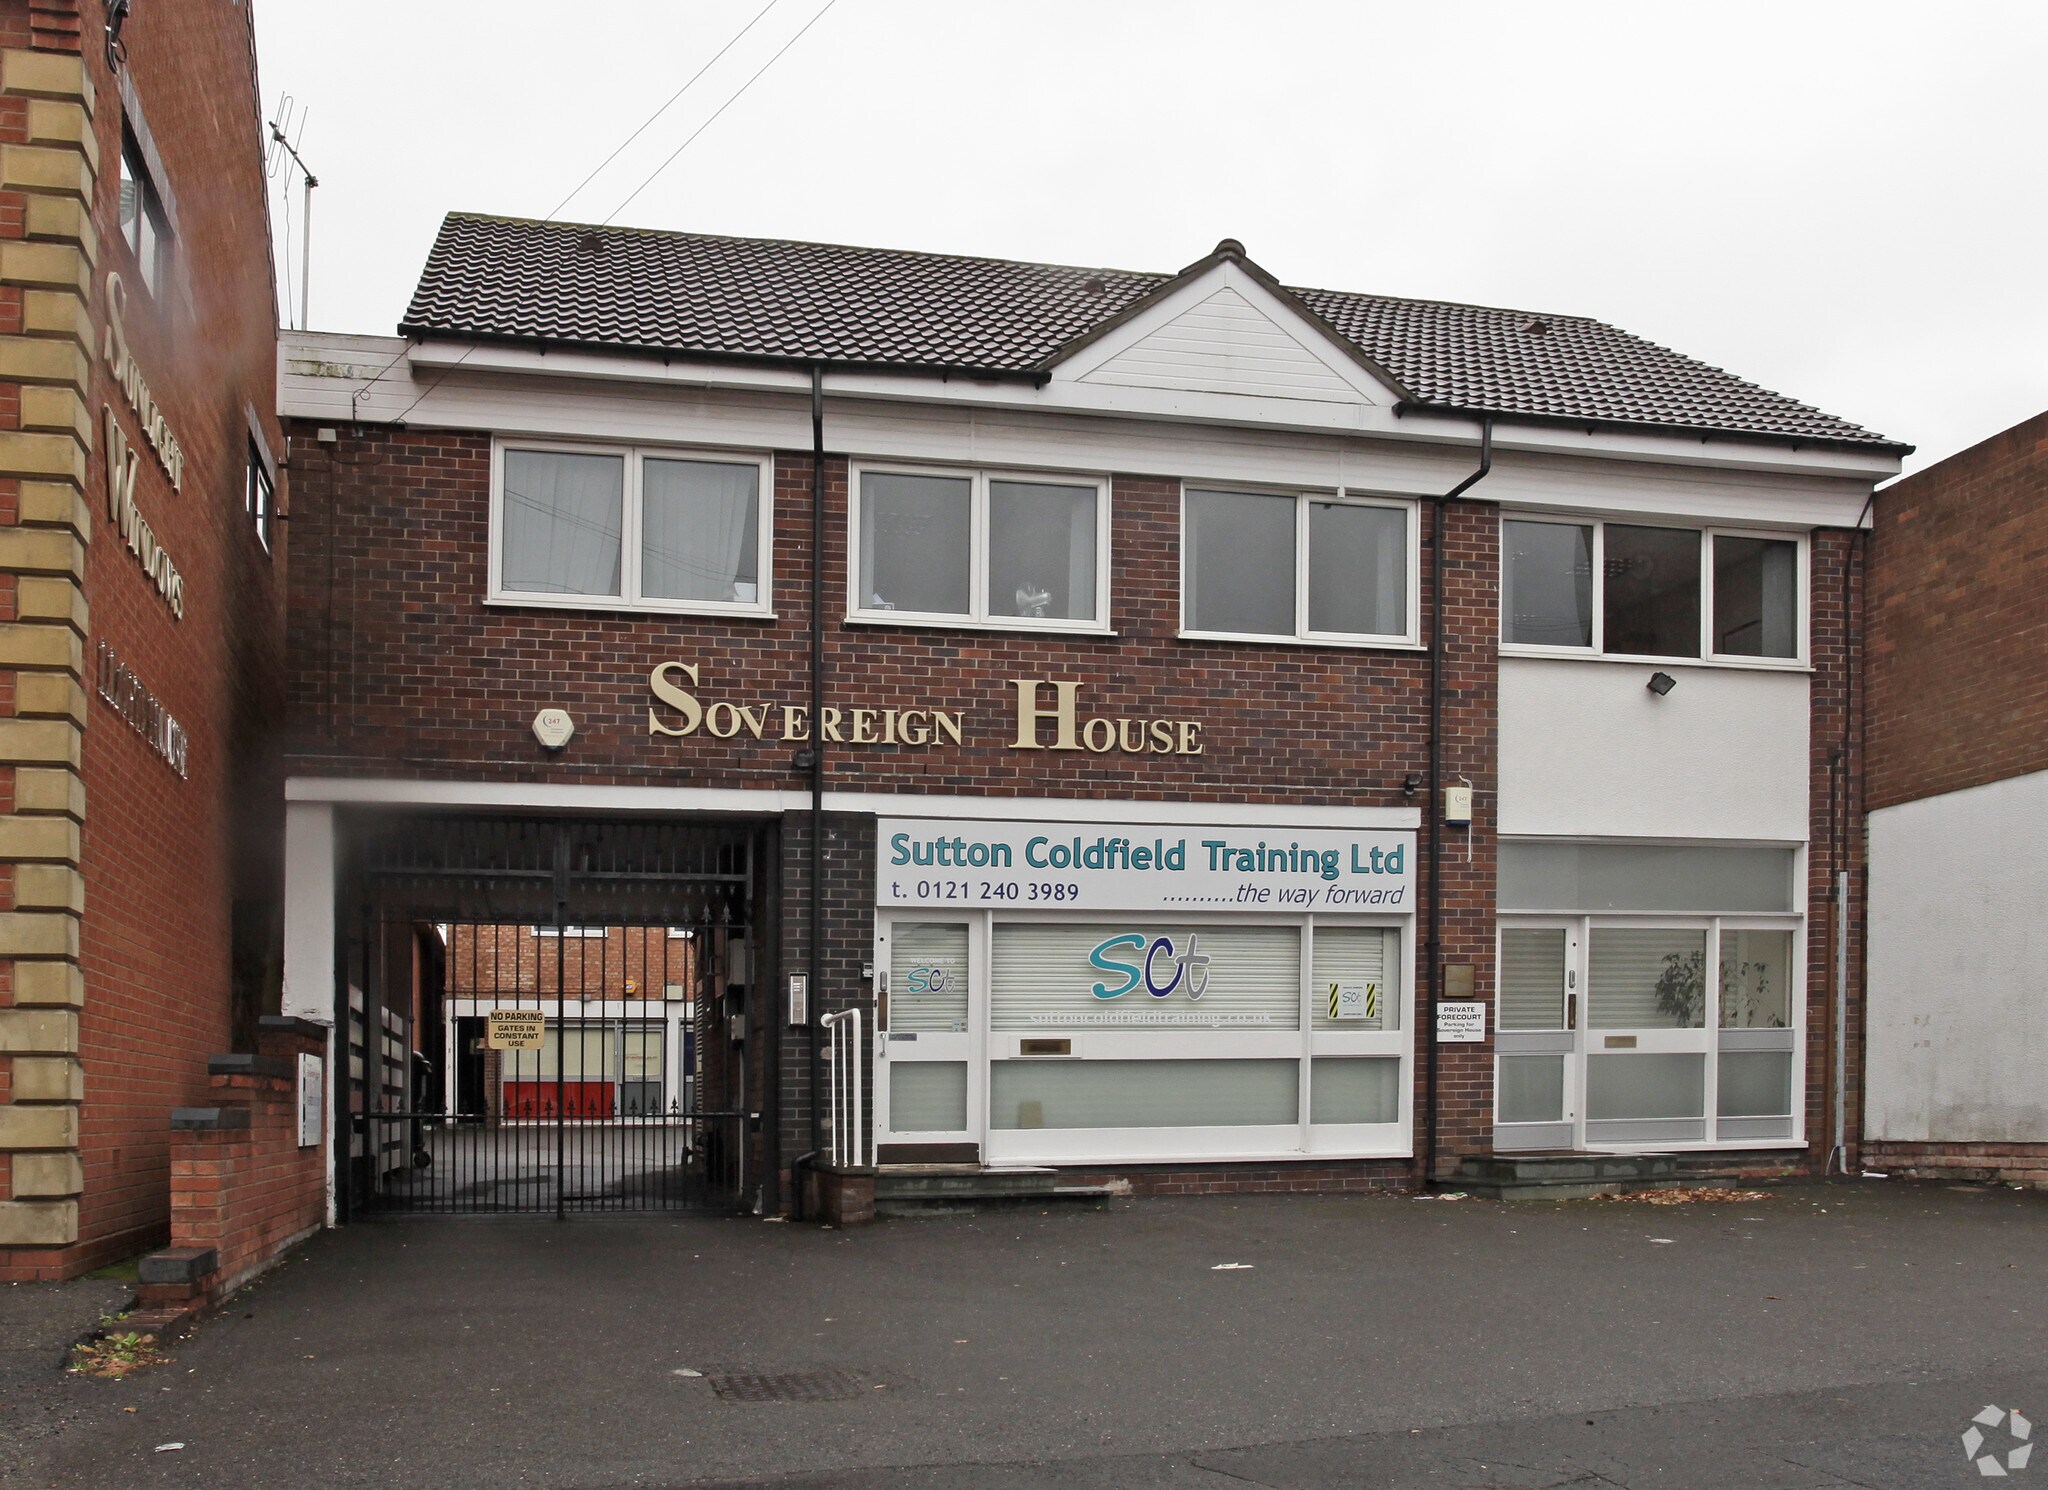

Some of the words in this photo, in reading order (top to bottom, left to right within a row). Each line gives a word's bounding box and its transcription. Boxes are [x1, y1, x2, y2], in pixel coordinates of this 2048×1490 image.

[890, 833, 1012, 868] Sutton
[1025, 836, 1186, 871] Coldfield
[1201, 840, 1340, 880] Training
[1350, 843, 1405, 874] Ltd
[891, 881, 908, 899] t.
[917, 880, 969, 899] 0121
[980, 882, 1019, 900] 240
[1028, 883, 1080, 901] 3989
[1278, 887, 1321, 908] way
[1325, 885, 1406, 904] forward
